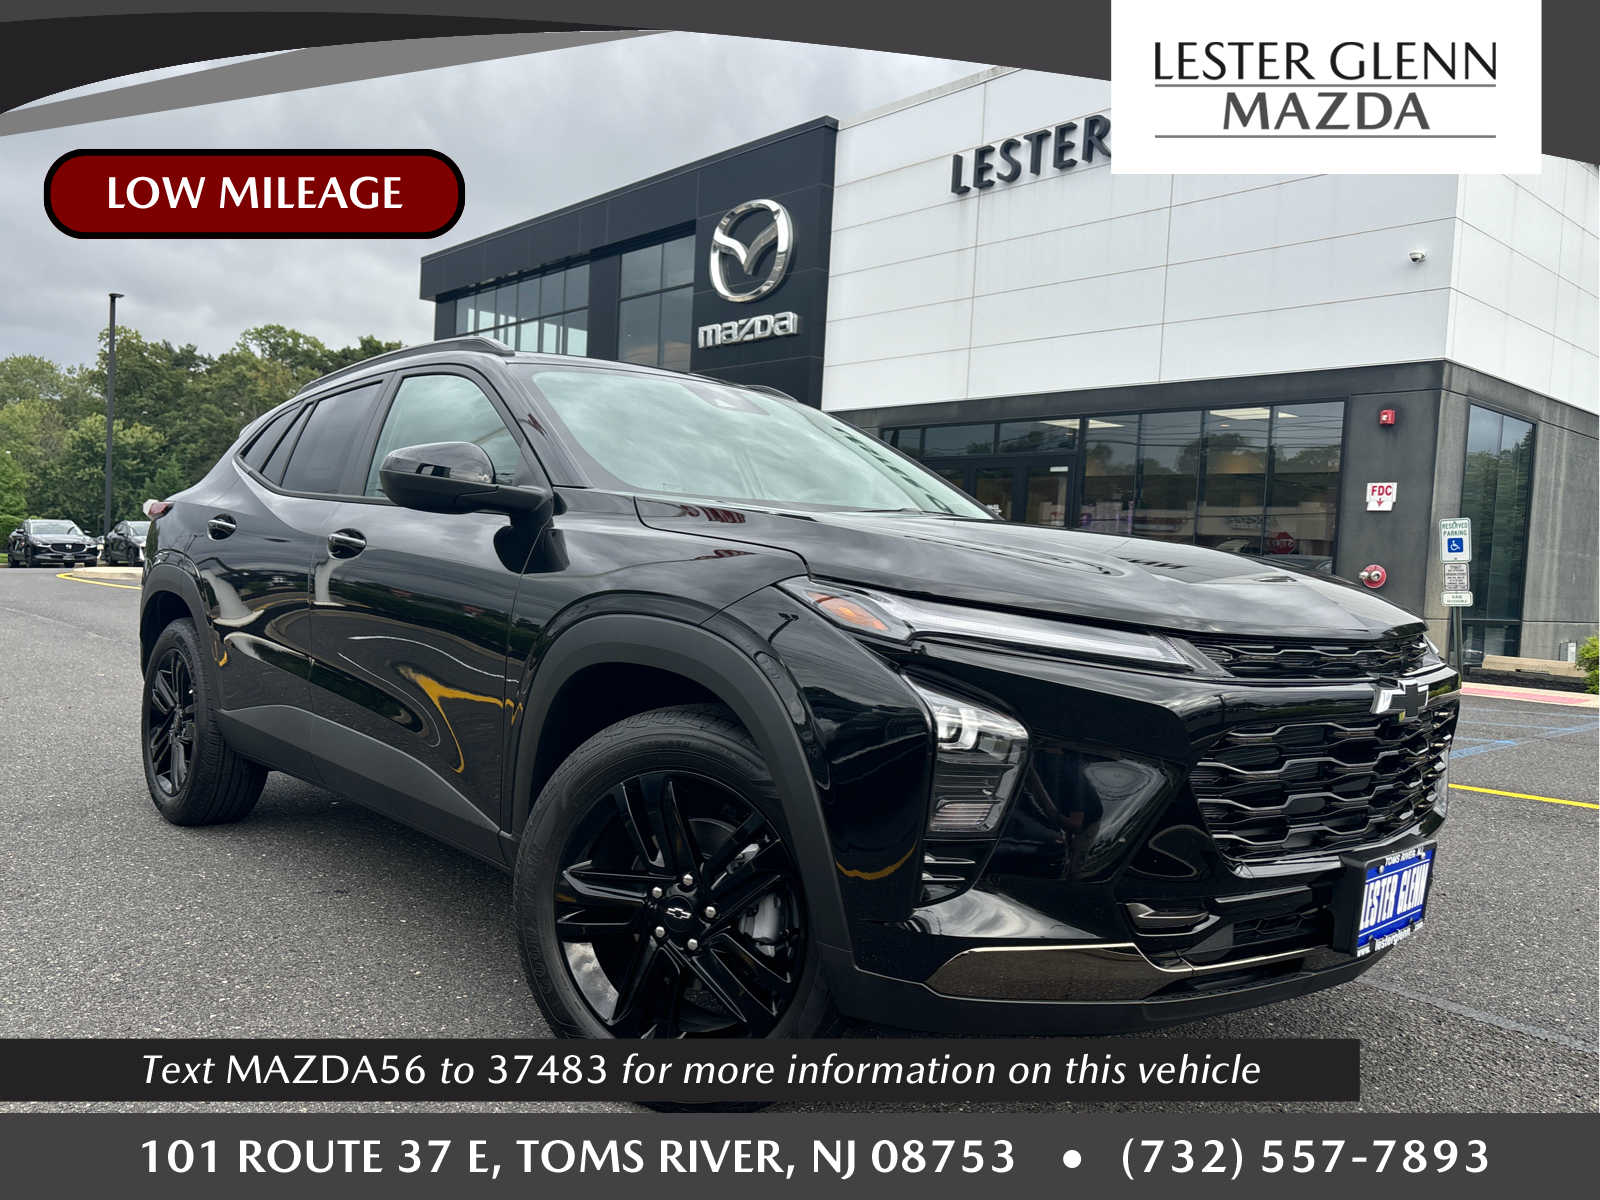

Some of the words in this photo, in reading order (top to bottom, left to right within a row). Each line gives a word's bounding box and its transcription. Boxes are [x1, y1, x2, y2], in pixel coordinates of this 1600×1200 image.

[951, 114, 1112, 195] LESTER
[1371, 485, 1392, 496] FDC
[1359, 874, 1399, 931] LESTER
[1396, 862, 1430, 915] GLENN
